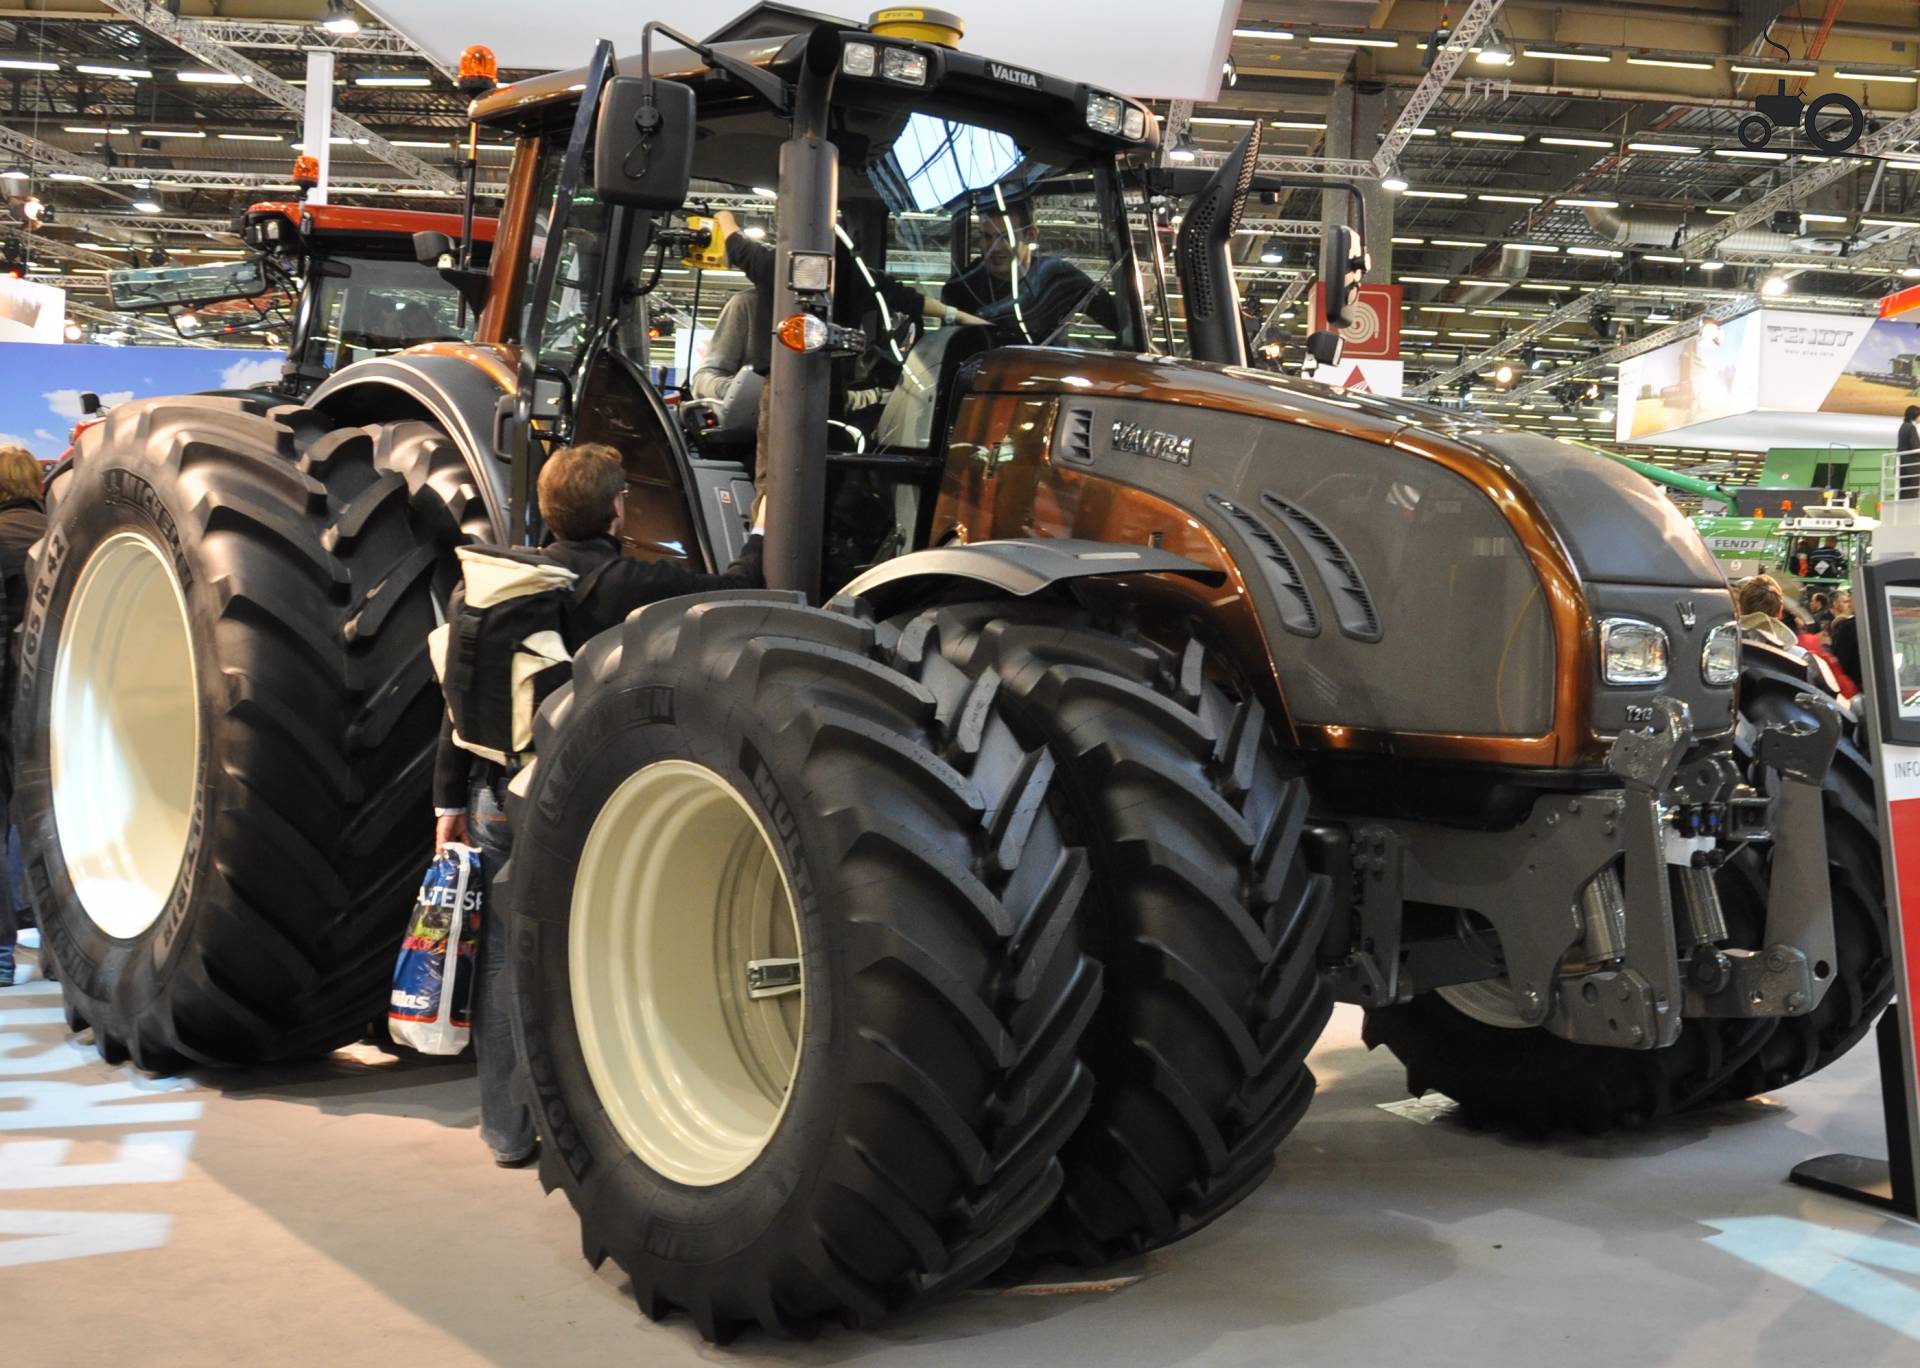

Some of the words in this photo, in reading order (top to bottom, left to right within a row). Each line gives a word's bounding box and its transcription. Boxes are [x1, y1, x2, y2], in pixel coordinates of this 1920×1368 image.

[991, 63, 1037, 87] VALTRA
[1714, 539, 1760, 549] FENDT
[1894, 760, 1920, 778] INFO
